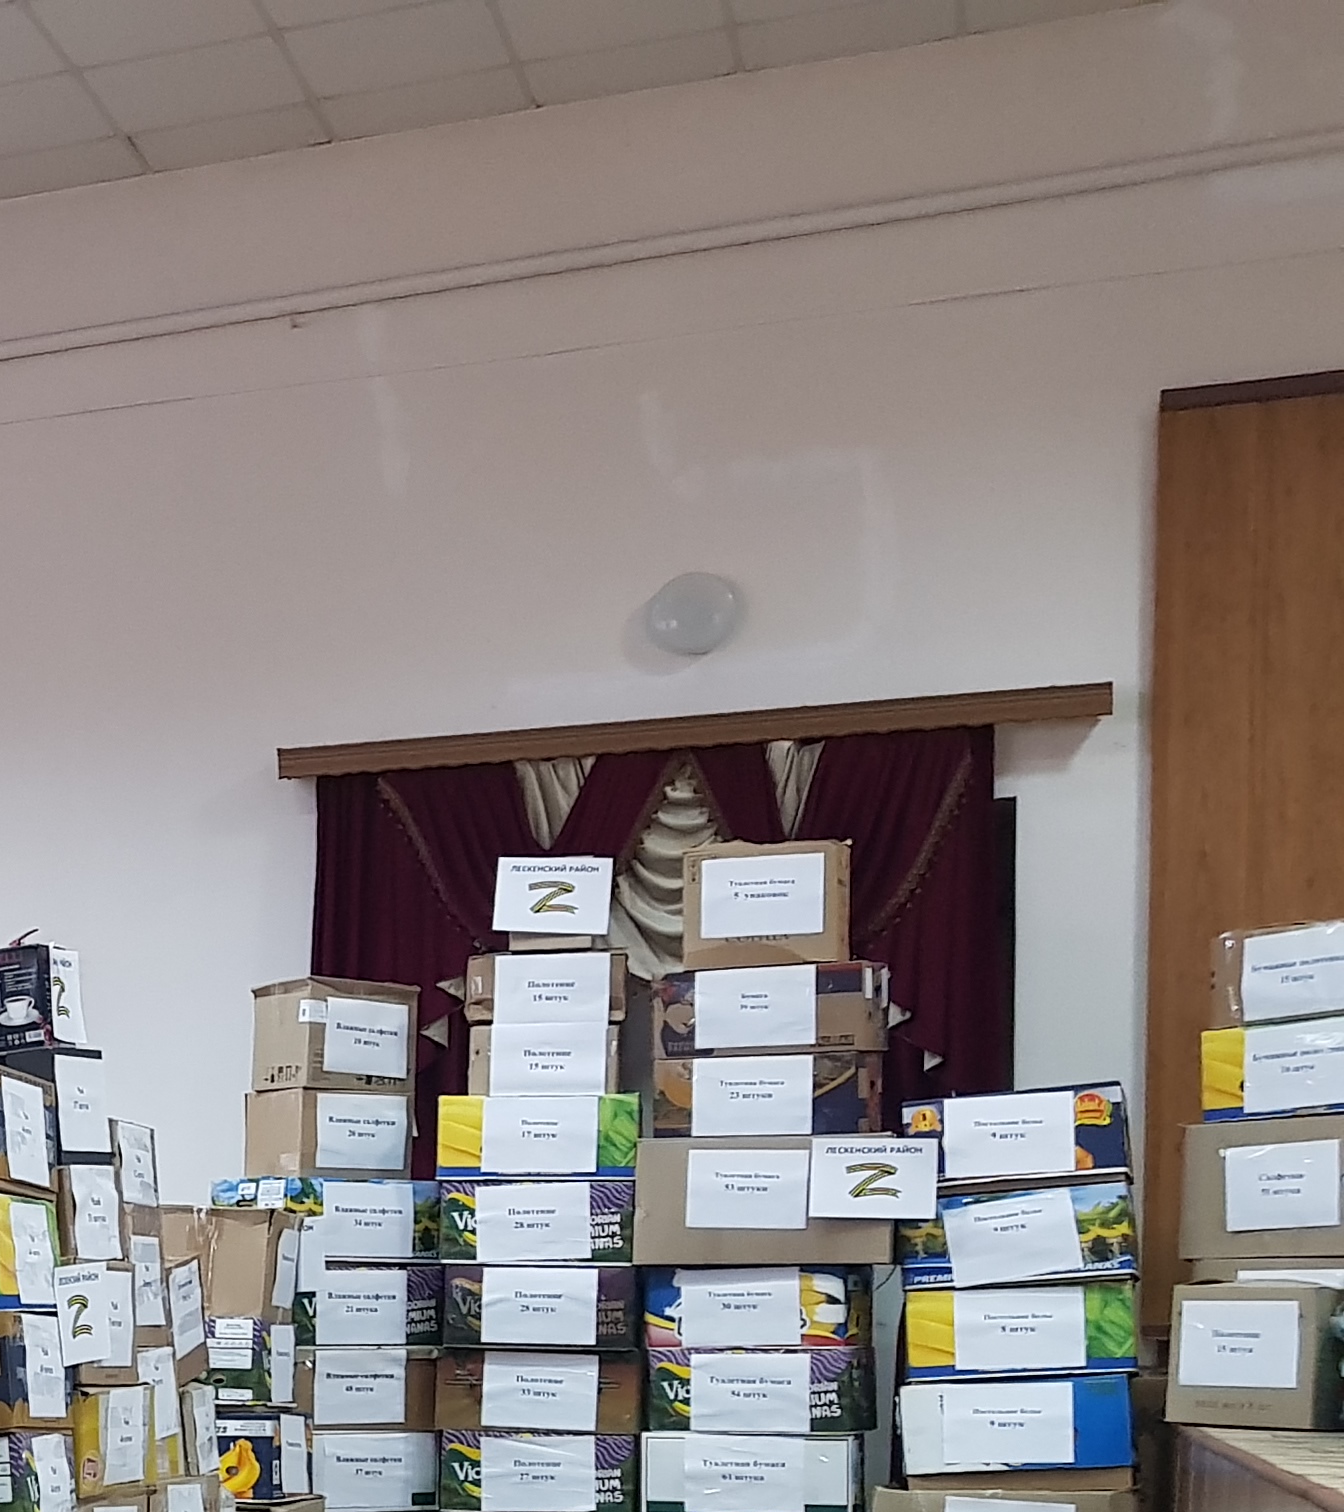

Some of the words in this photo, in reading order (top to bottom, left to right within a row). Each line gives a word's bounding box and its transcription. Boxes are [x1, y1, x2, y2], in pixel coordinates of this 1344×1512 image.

[510, 863, 567, 873] ЛЕСКЕНСКИЙ
[568, 863, 600, 873] РАЙОН
[825, 1144, 888, 1155] ЛЕСКЕНСКИЙ
[889, 1144, 924, 1155] РАЙОН
